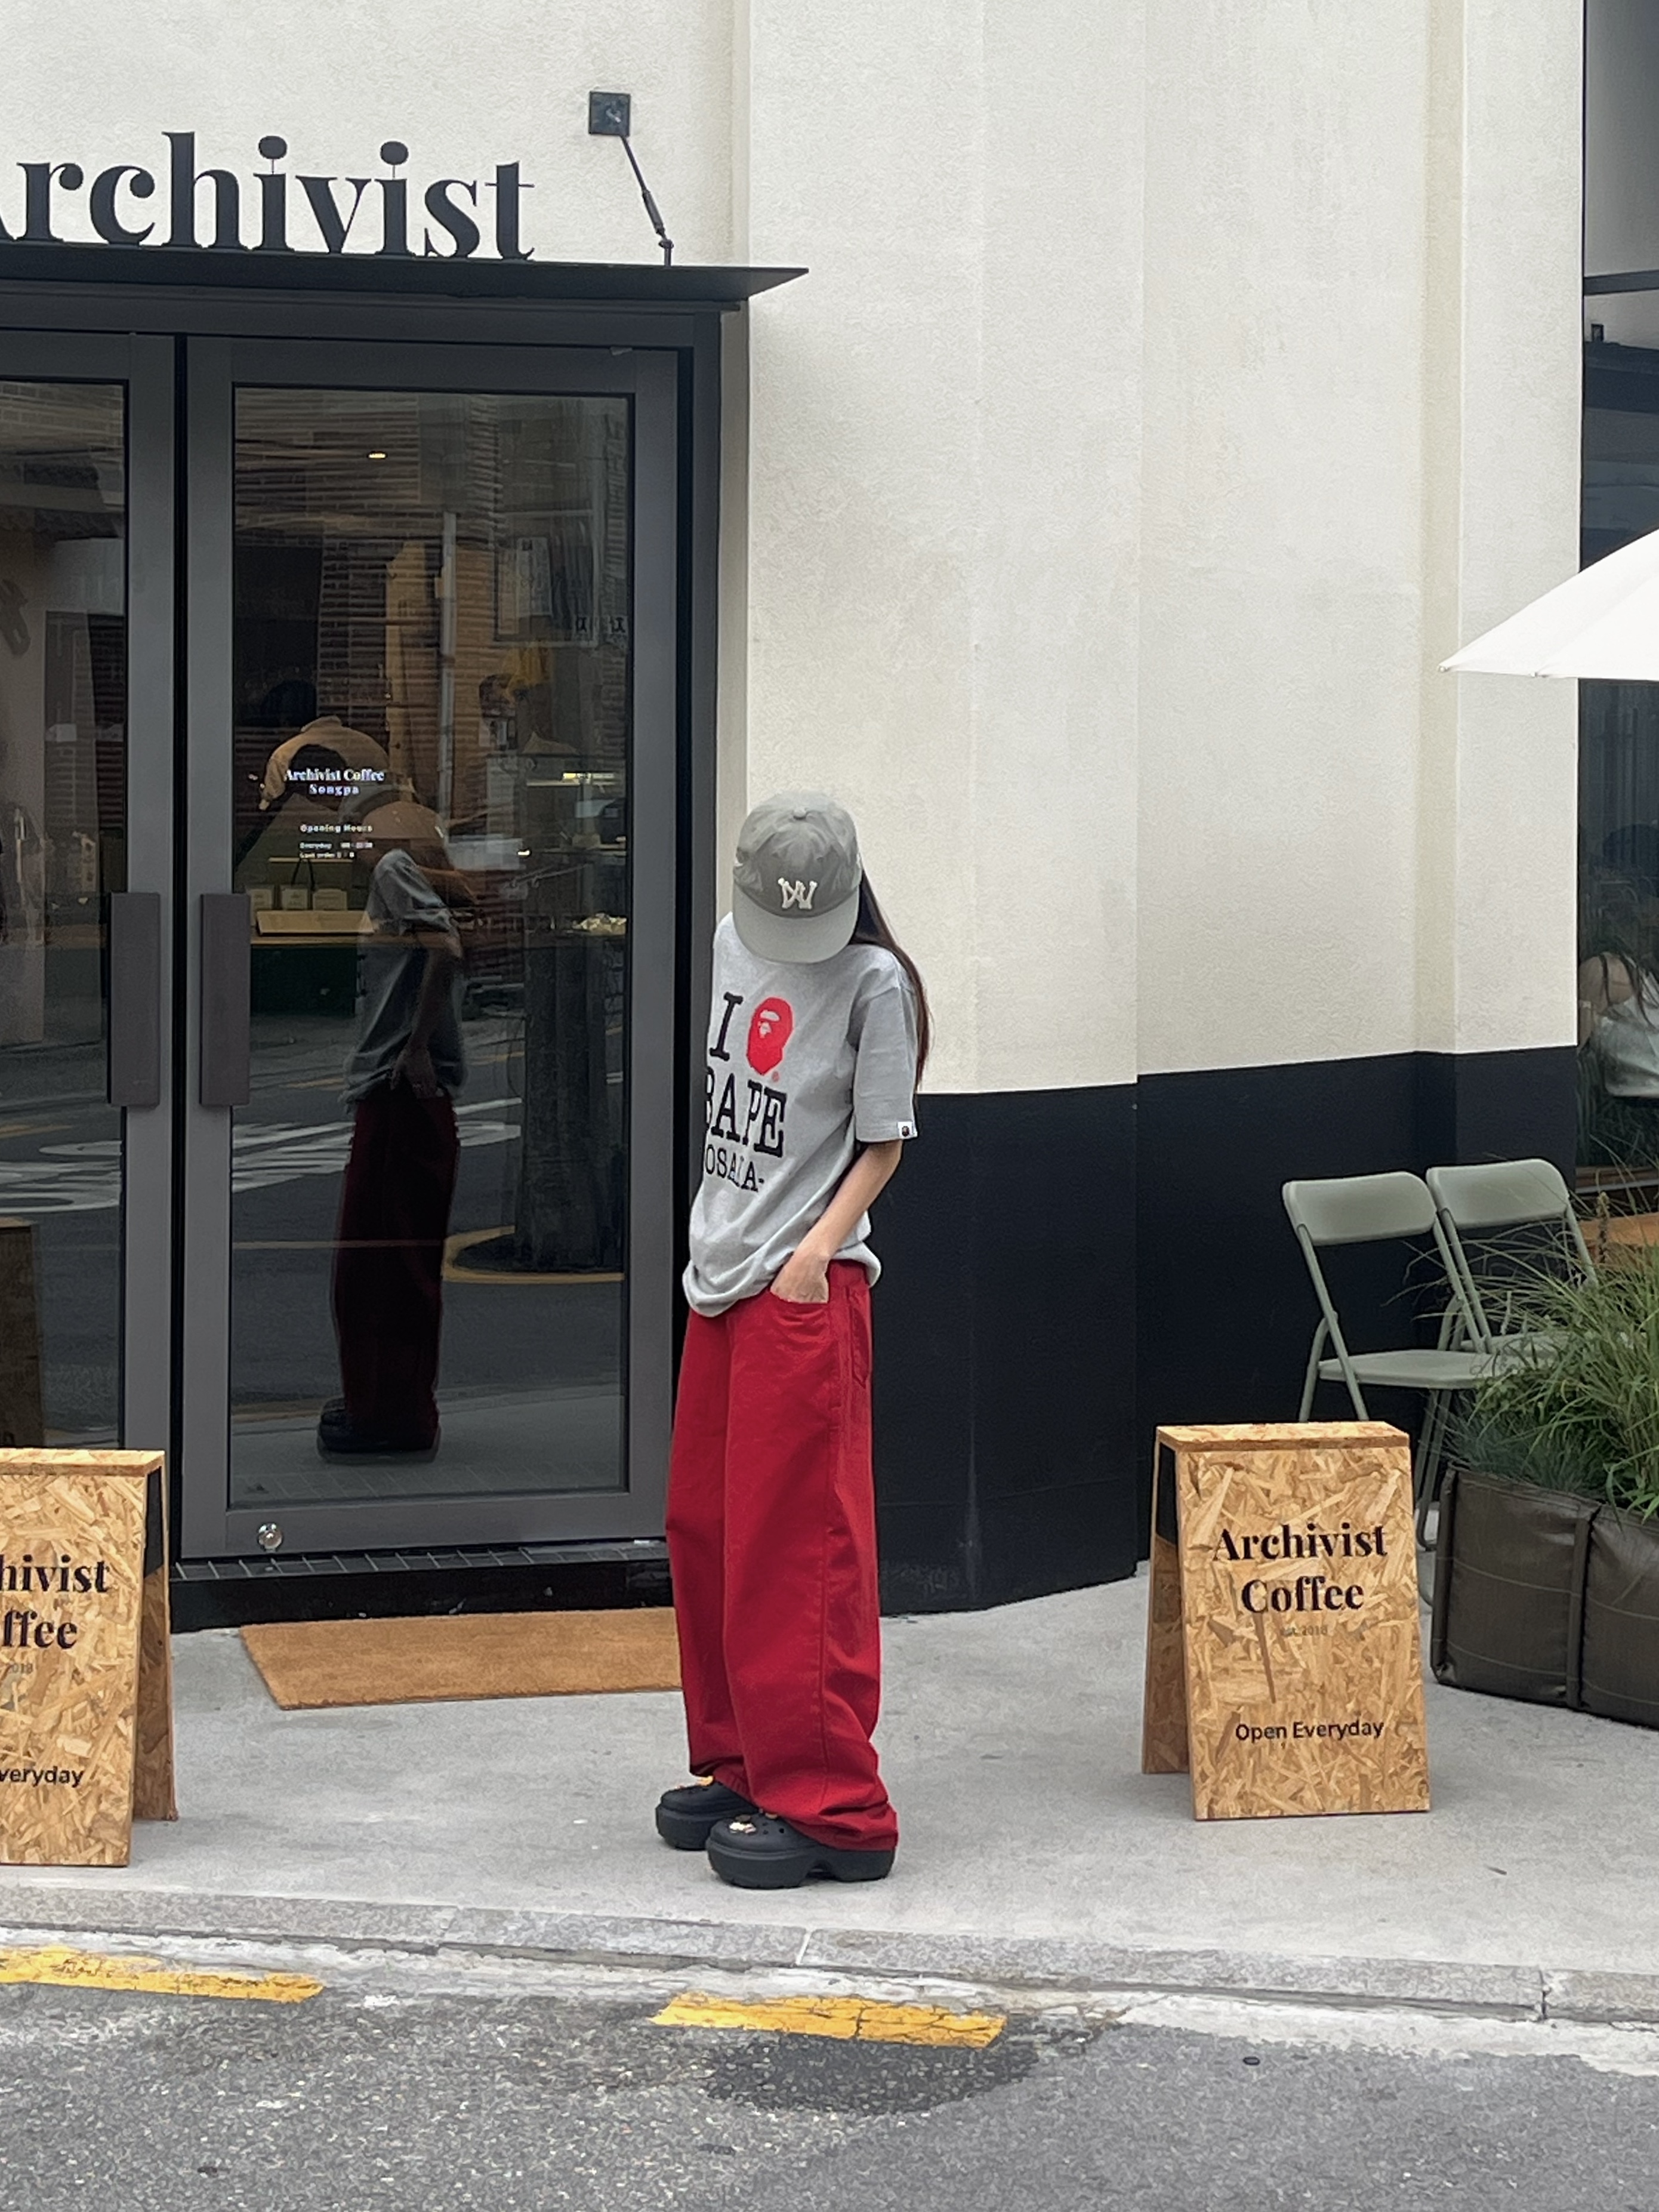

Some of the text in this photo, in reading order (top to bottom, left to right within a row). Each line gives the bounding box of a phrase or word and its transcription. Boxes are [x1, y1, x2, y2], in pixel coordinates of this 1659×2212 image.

[0, 131, 535, 261] rchivist
[283, 768, 385, 781] Archivist Coffee
[1212, 1522, 1388, 1561] Archivist
[1241, 1576, 1365, 1613] Coffee
[1235, 1719, 1384, 1743] Open Everyday
